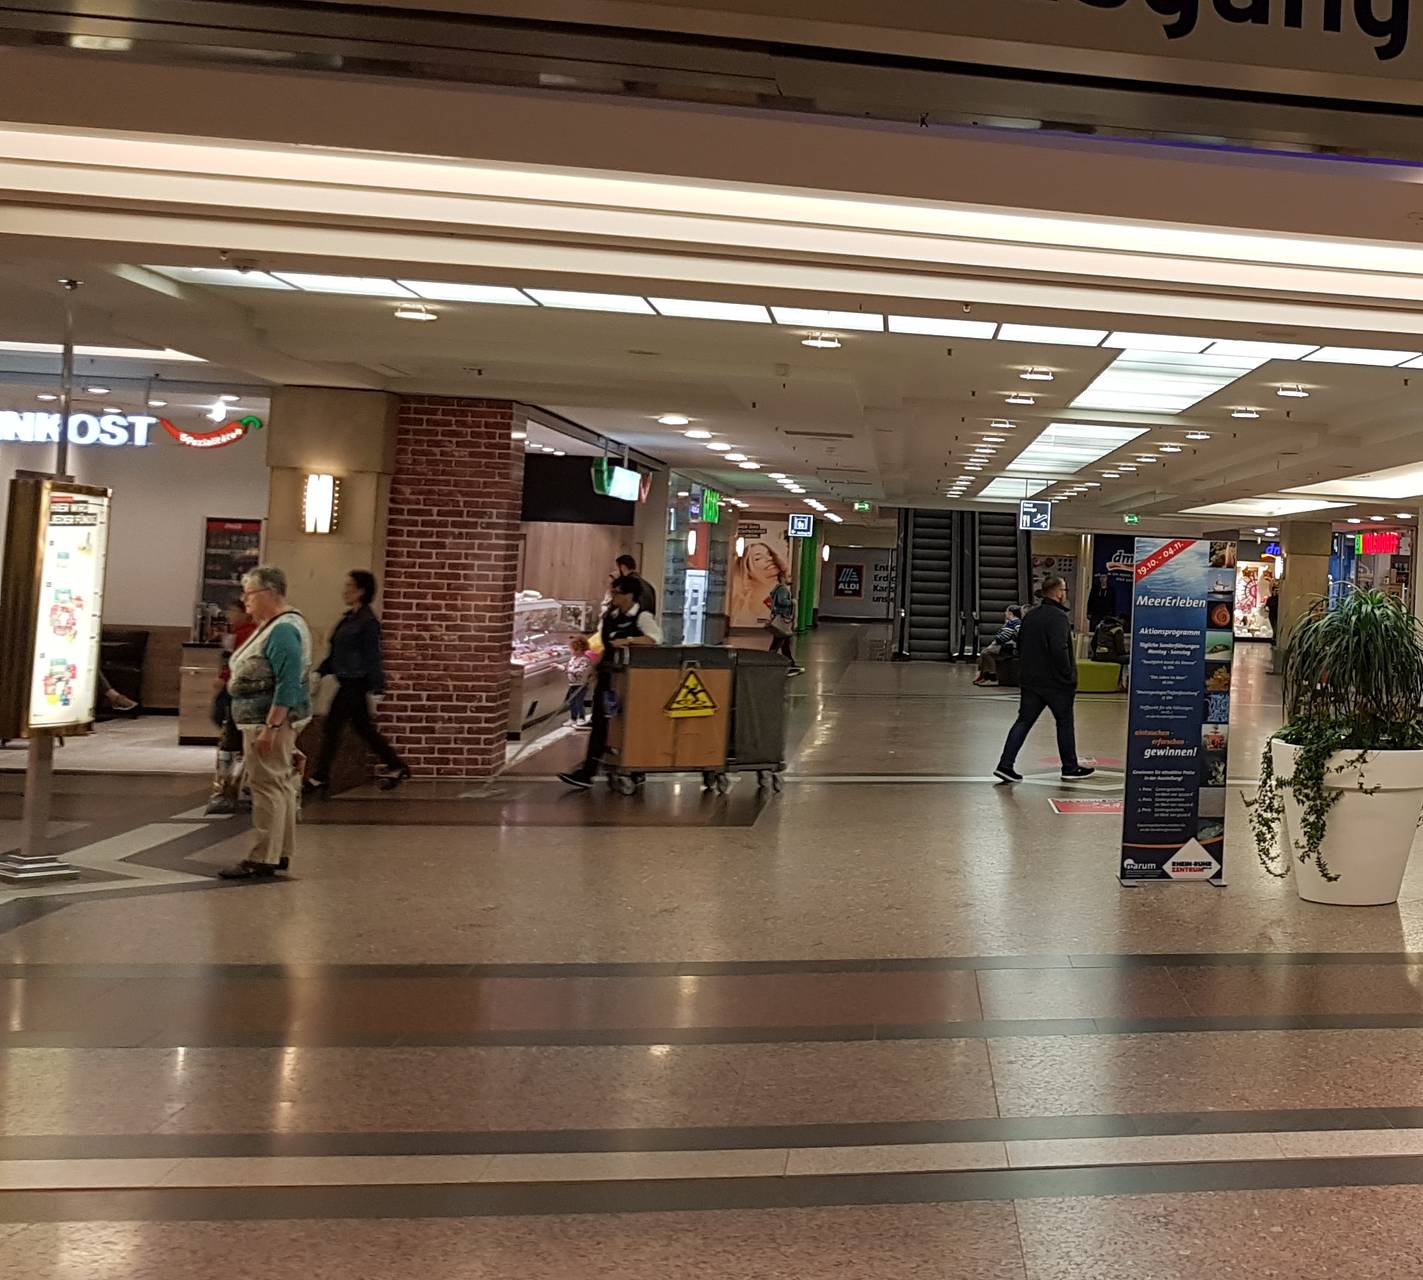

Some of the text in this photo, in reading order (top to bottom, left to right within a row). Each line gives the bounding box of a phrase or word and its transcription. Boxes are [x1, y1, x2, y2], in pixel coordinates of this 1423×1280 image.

[1137, 559, 1159, 576] 19.10.
[1163, 541, 1184, 557] 04.11.
[1136, 595, 1206, 608] MeerErleben
[1139, 627, 1200, 637] Aktionsprogramm
[1144, 747, 1198, 758] gewinnen!
